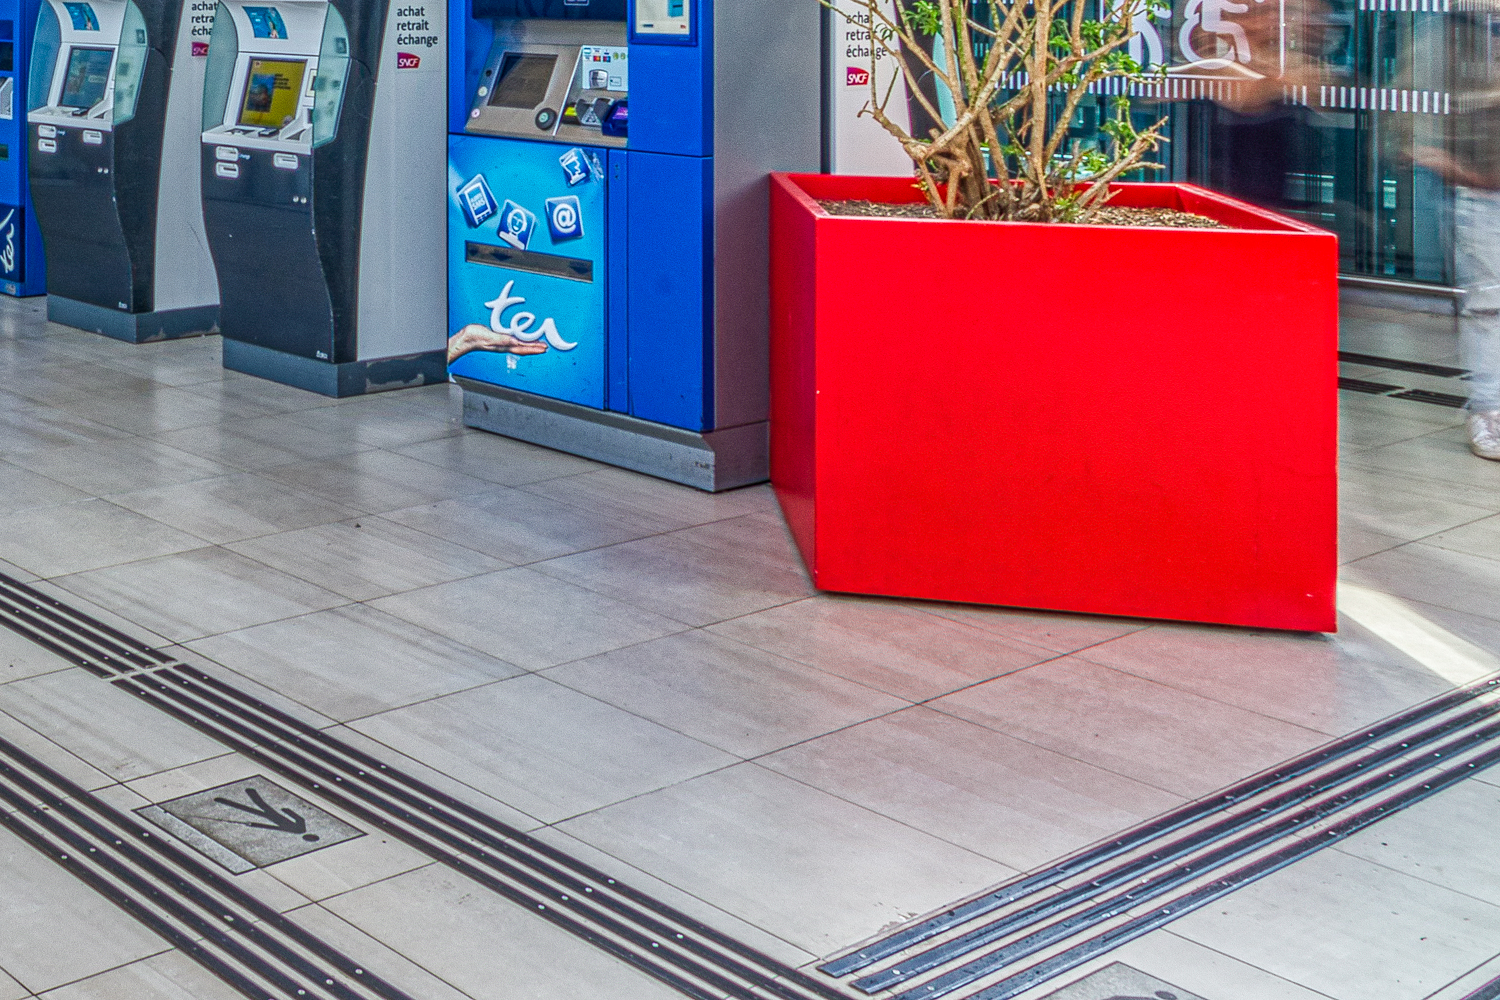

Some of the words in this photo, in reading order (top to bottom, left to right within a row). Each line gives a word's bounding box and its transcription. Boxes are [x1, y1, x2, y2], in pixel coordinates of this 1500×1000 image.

[397, 6, 425, 16] achat
[192, 14, 215, 23] retra
[846, 11, 870, 24] acha
[397, 20, 429, 30] retrait
[192, 26, 212, 35] écha
[846, 29, 871, 40] retra
[397, 34, 438, 48] échange
[193, 47, 208, 55] SNC
[846, 45, 887, 60] échage
[398, 58, 419, 67] SNCF
[848, 74, 868, 84] SNCF
[484, 280, 578, 351] ter
